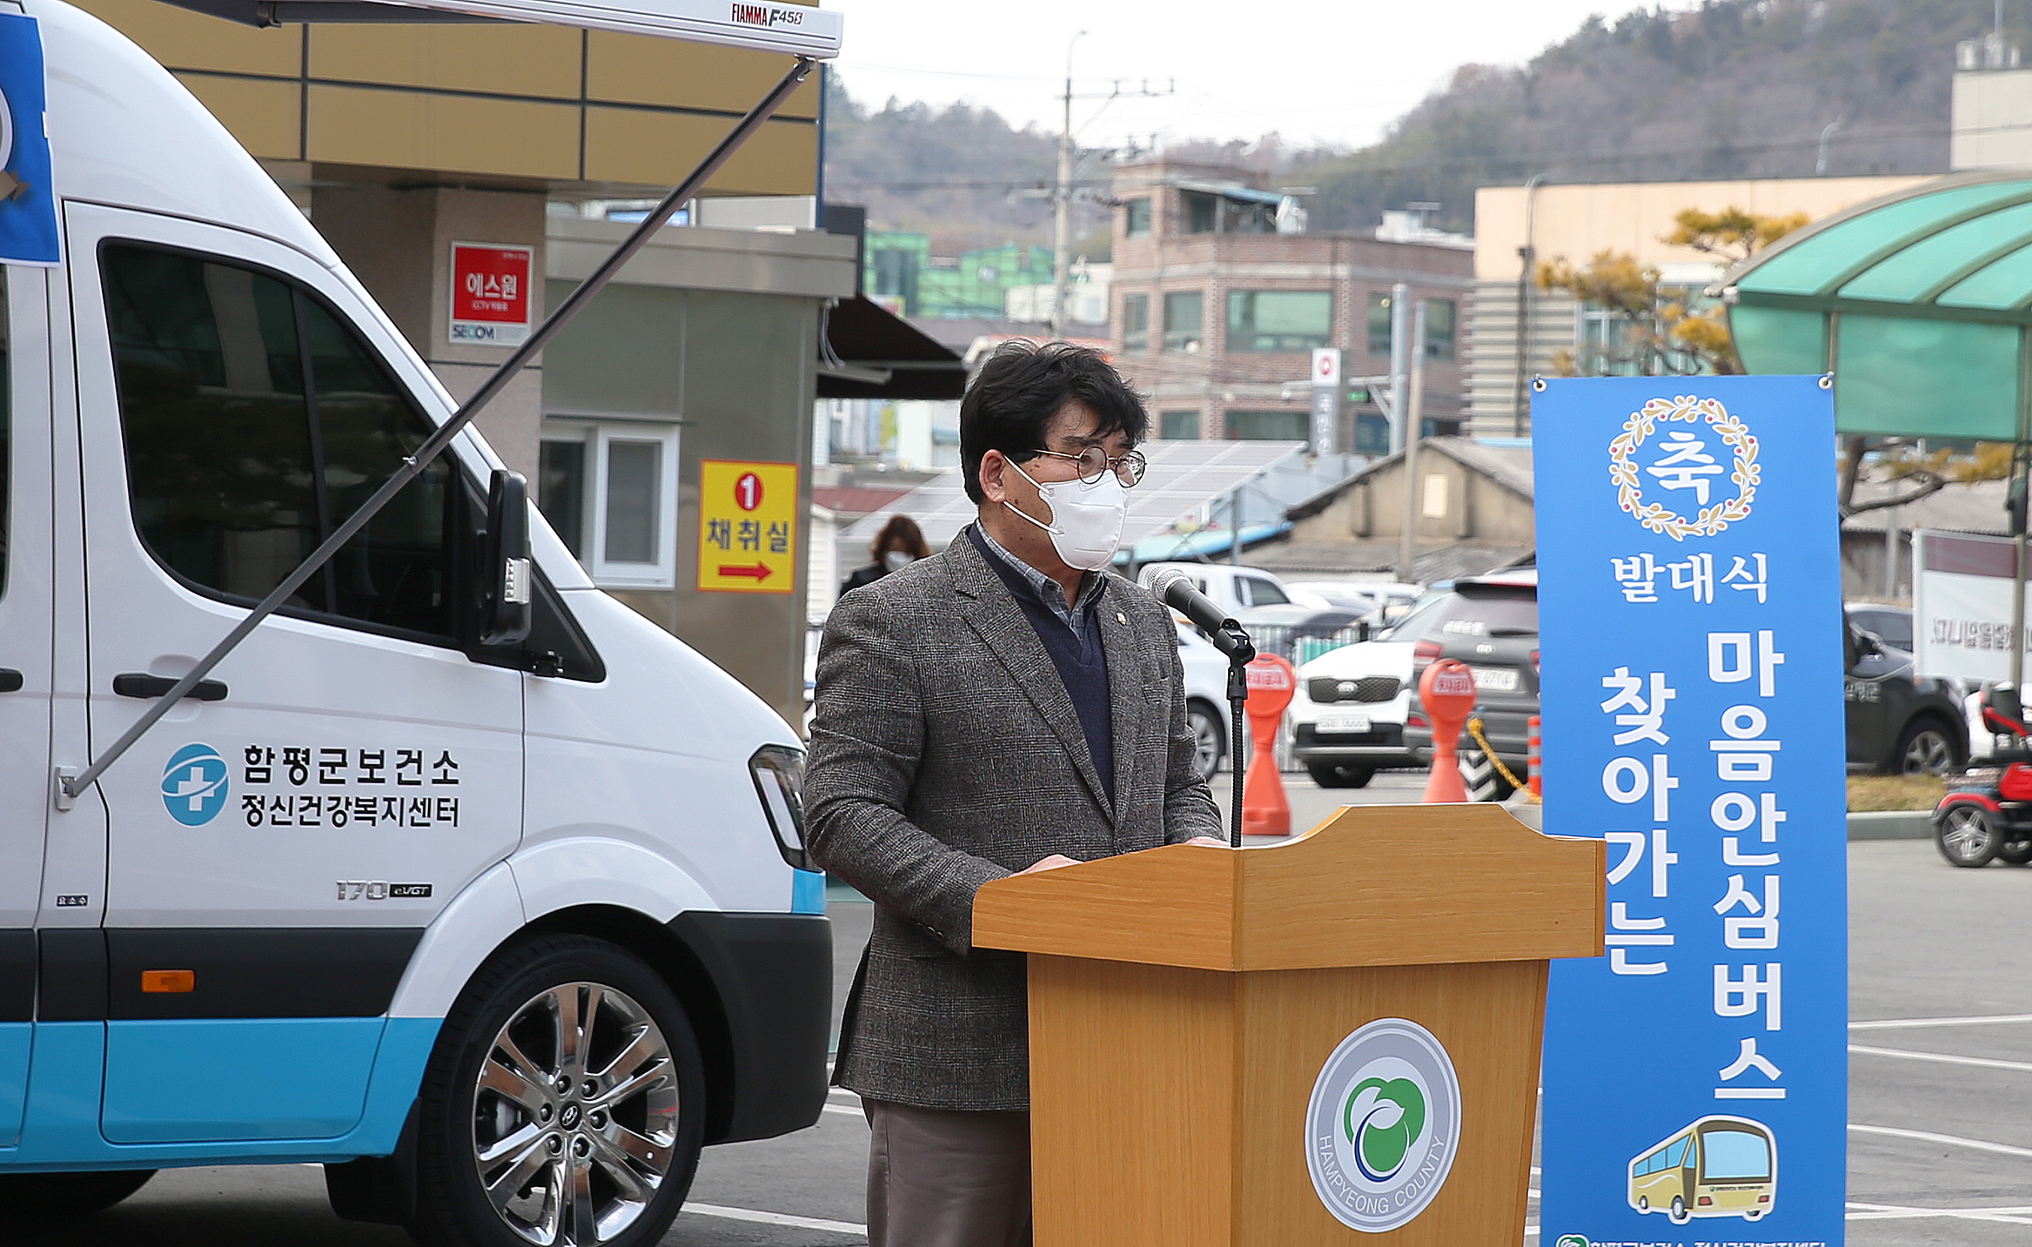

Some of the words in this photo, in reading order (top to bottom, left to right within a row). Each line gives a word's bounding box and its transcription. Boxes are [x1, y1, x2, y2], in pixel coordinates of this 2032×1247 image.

[731, 3, 768, 26] FIAMMA
[466, 272, 517, 300] 에스원
[453, 324, 495, 340] SECOM
[1646, 431, 1724, 505] 축
[740, 475, 755, 509] 1
[707, 518, 789, 553] 채취실
[1610, 552, 1768, 604] 발대식
[243, 745, 460, 786] 함평군보건소
[242, 794, 460, 828] 정신건강복지센터
[1601, 666, 1679, 975] 찾아가는
[1707, 629, 1787, 1099] 마음안심버스
[58, 896, 87, 906] 요소수
[337, 880, 388, 900] 170
[1319, 1135, 1390, 1214] HAMPYEONG
[1394, 1135, 1446, 1208] COUNTY
